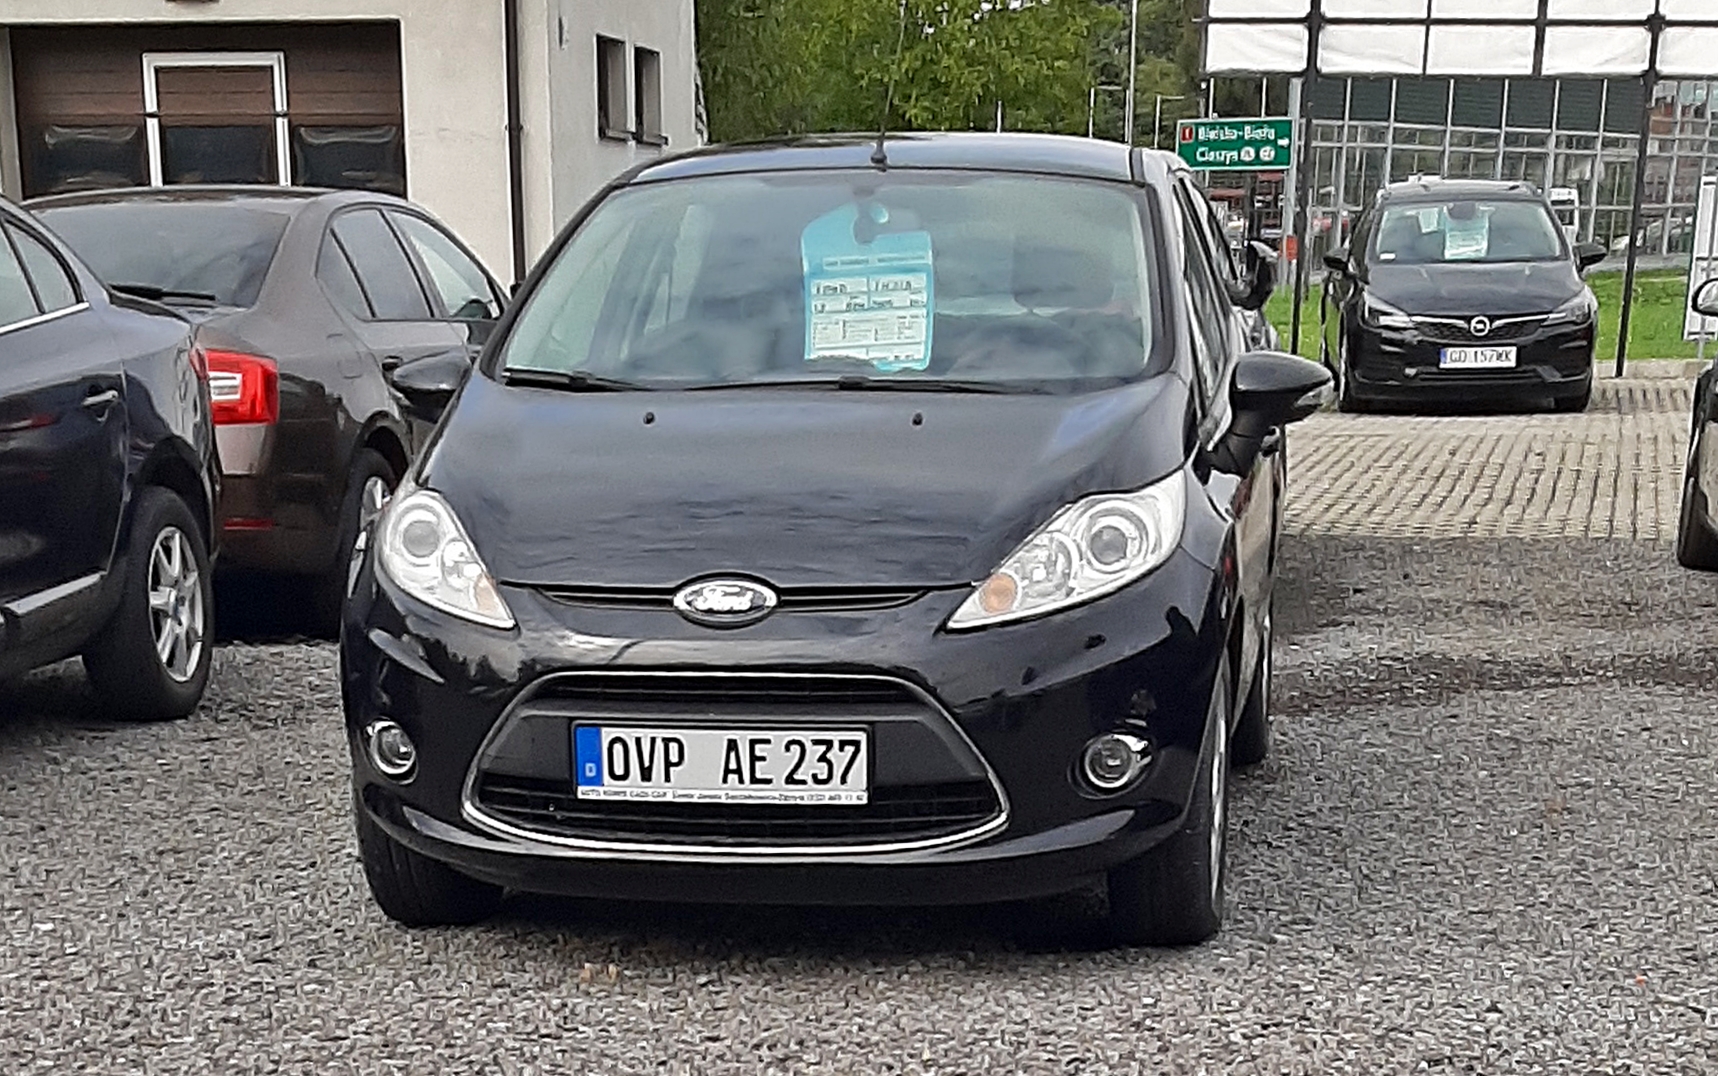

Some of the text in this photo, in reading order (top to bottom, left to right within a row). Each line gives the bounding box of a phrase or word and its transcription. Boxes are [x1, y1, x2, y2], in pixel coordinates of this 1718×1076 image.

[1449, 350, 1467, 363] GD
[607, 736, 862, 785] OVP AE 237
